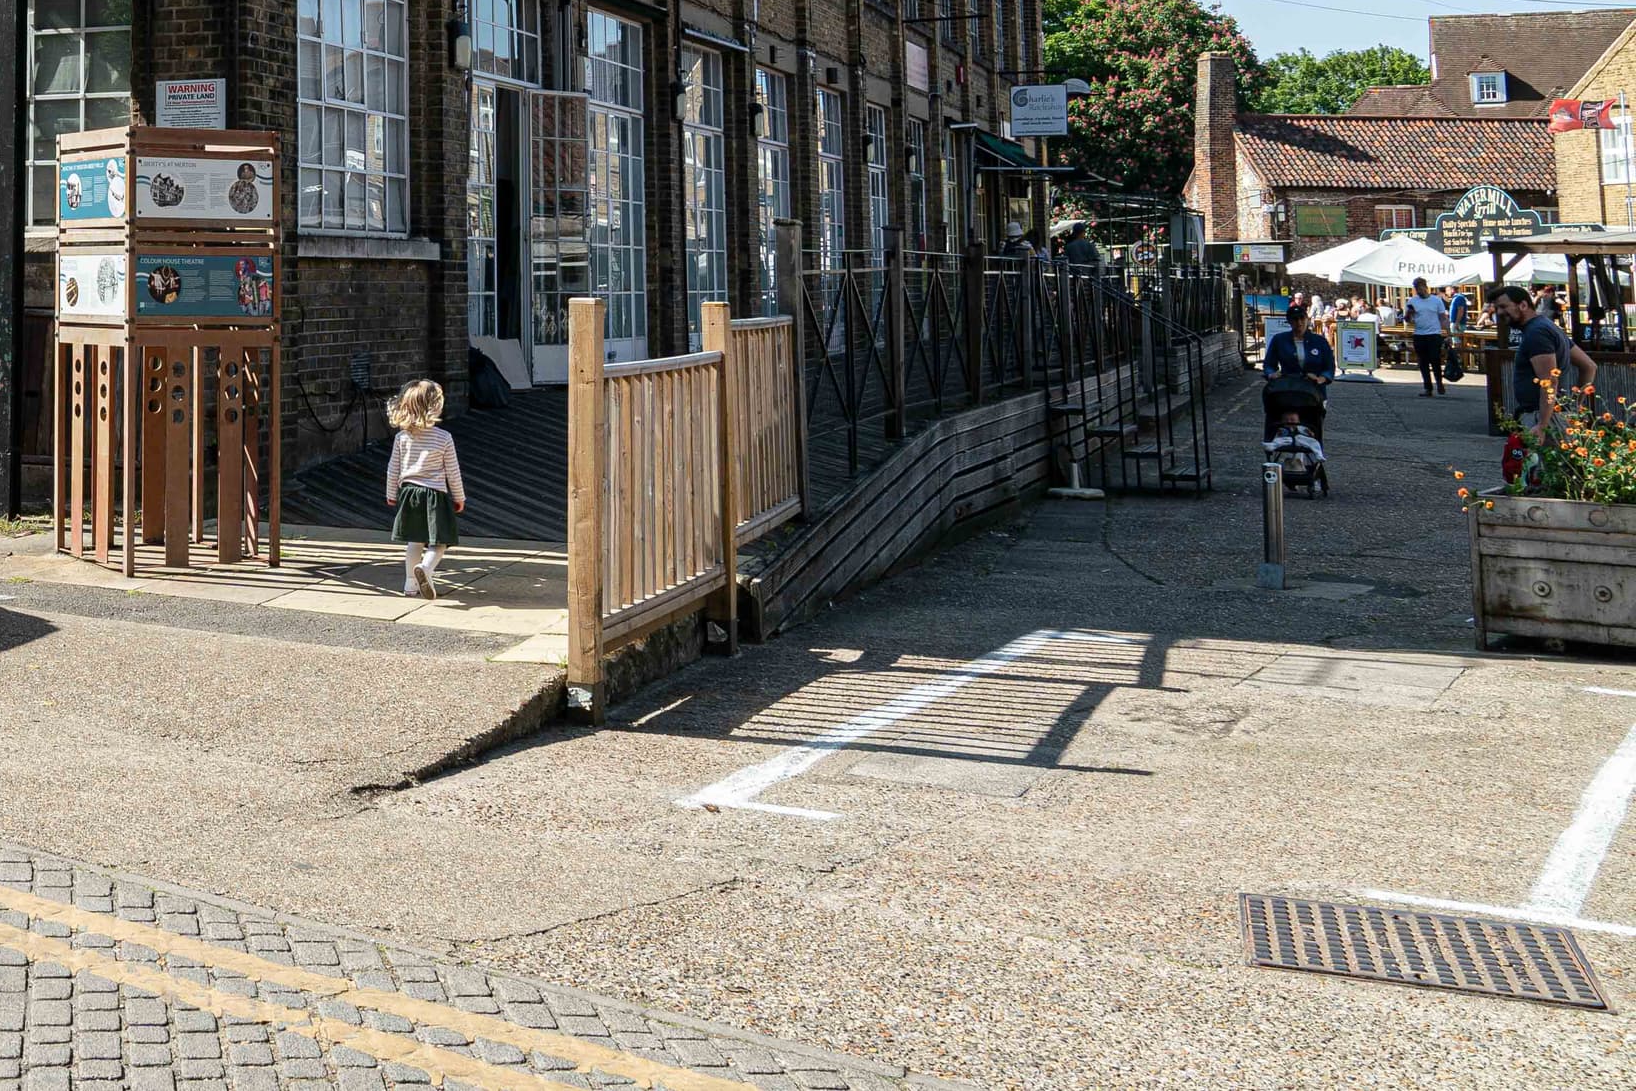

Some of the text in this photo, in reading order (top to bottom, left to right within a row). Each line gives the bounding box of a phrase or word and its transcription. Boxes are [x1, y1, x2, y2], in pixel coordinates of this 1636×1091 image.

[167, 83, 215, 94] WARNING
[1456, 188, 1513, 218] WATERMILL
[1473, 200, 1497, 220] Grill
[1398, 261, 1456, 275] PRAVHA
